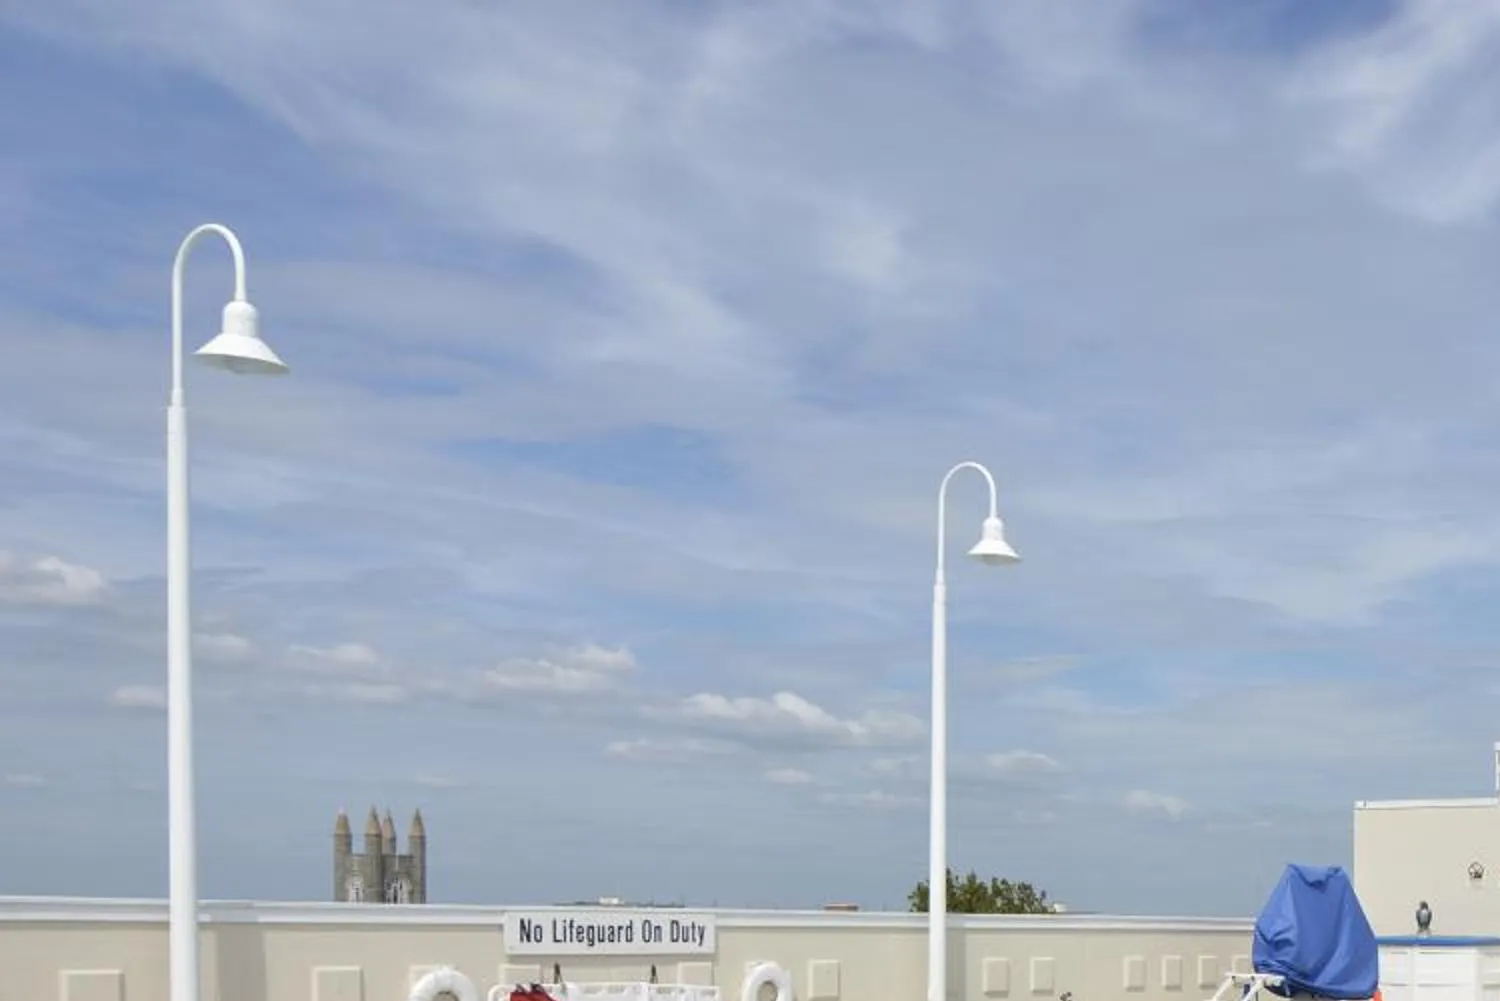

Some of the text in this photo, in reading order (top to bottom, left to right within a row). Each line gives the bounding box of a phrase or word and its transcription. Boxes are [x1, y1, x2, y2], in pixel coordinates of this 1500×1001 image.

[519, 918, 706, 946] No Lifeguard On Duty
